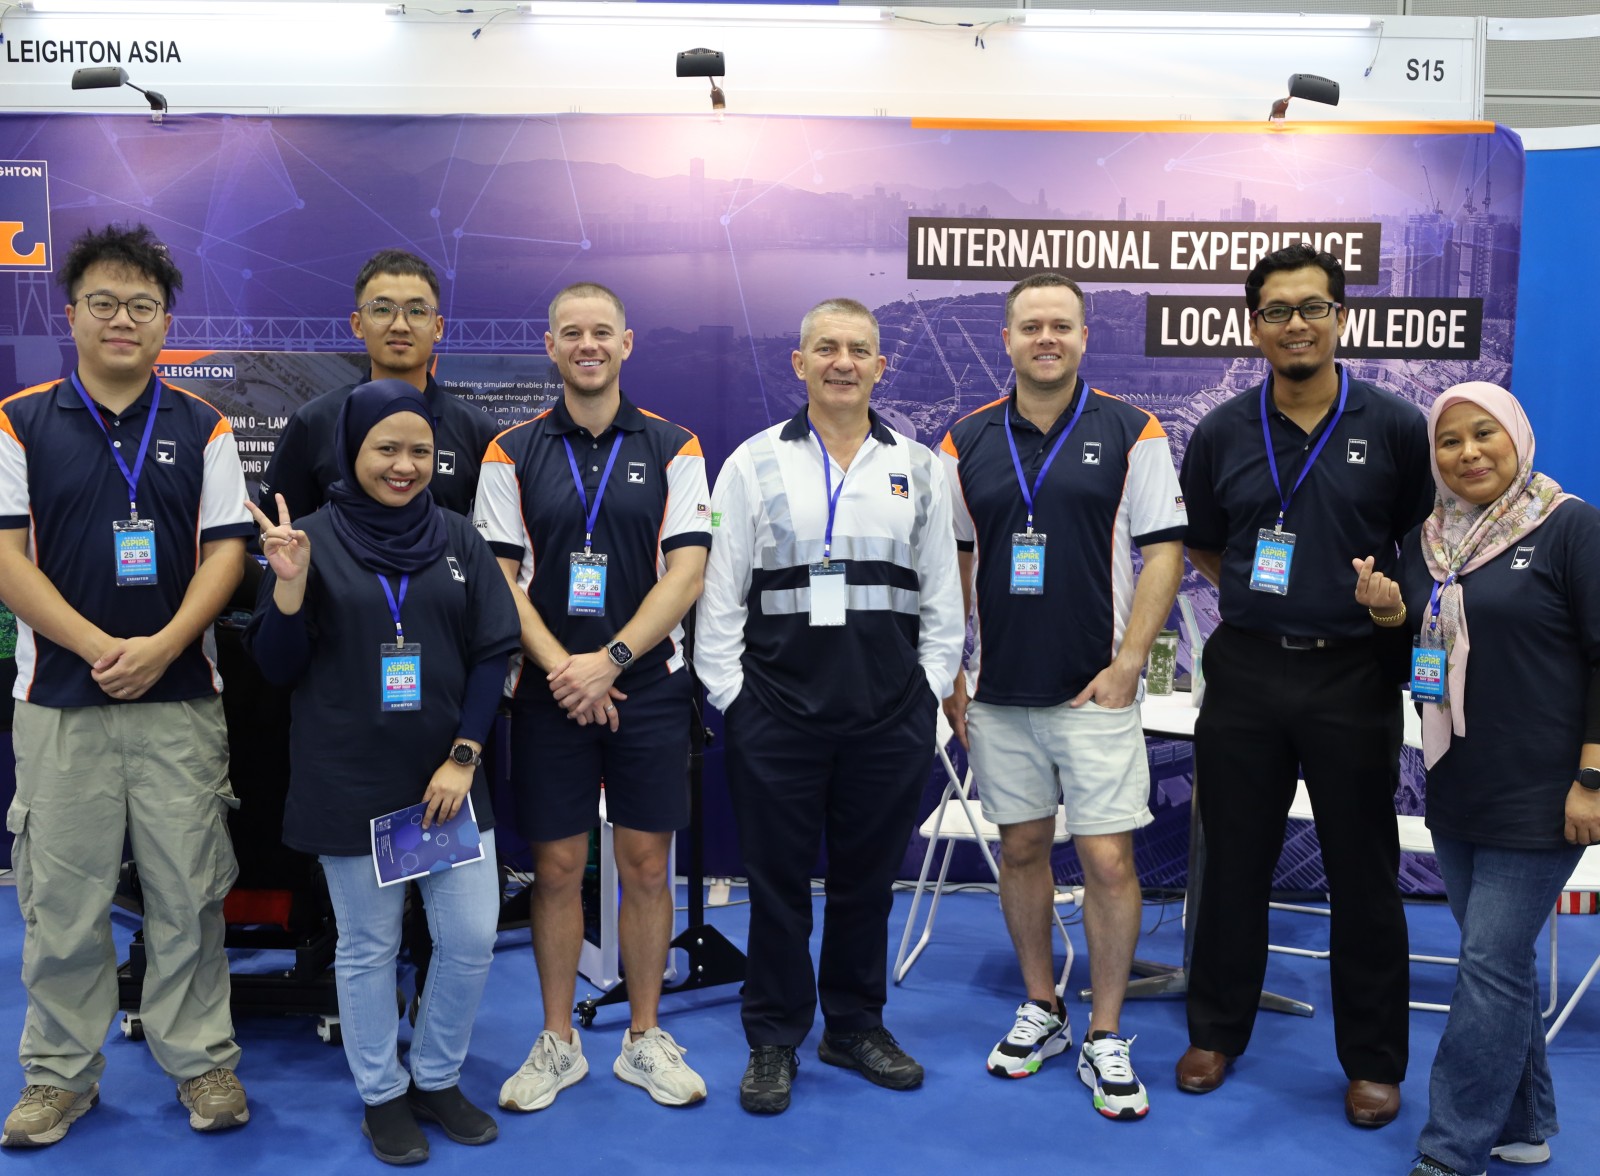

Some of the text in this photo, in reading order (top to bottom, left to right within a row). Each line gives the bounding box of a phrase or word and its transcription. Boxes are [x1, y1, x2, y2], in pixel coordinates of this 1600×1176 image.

[7, 40, 182, 63] LEIGHTON ASIA
[1406, 58, 1444, 82] S15
[0, 166, 42, 177] HTON
[917, 227, 1160, 270] INTERNATIONAL
[1340, 308, 1467, 348] WLEDGE
[164, 366, 234, 378] LEIGHTON
[459, 381, 482, 389] driving
[504, 394, 532, 402] through
[248, 416, 256, 428] O
[238, 441, 274, 452] RIVING
[241, 460, 262, 472] ONG
[121, 539, 150, 547] ASPIRE
[1261, 548, 1287, 558] ASPIRE
[1416, 656, 1440, 665] ASPIRE
[387, 664, 415, 672] ASPIRE
